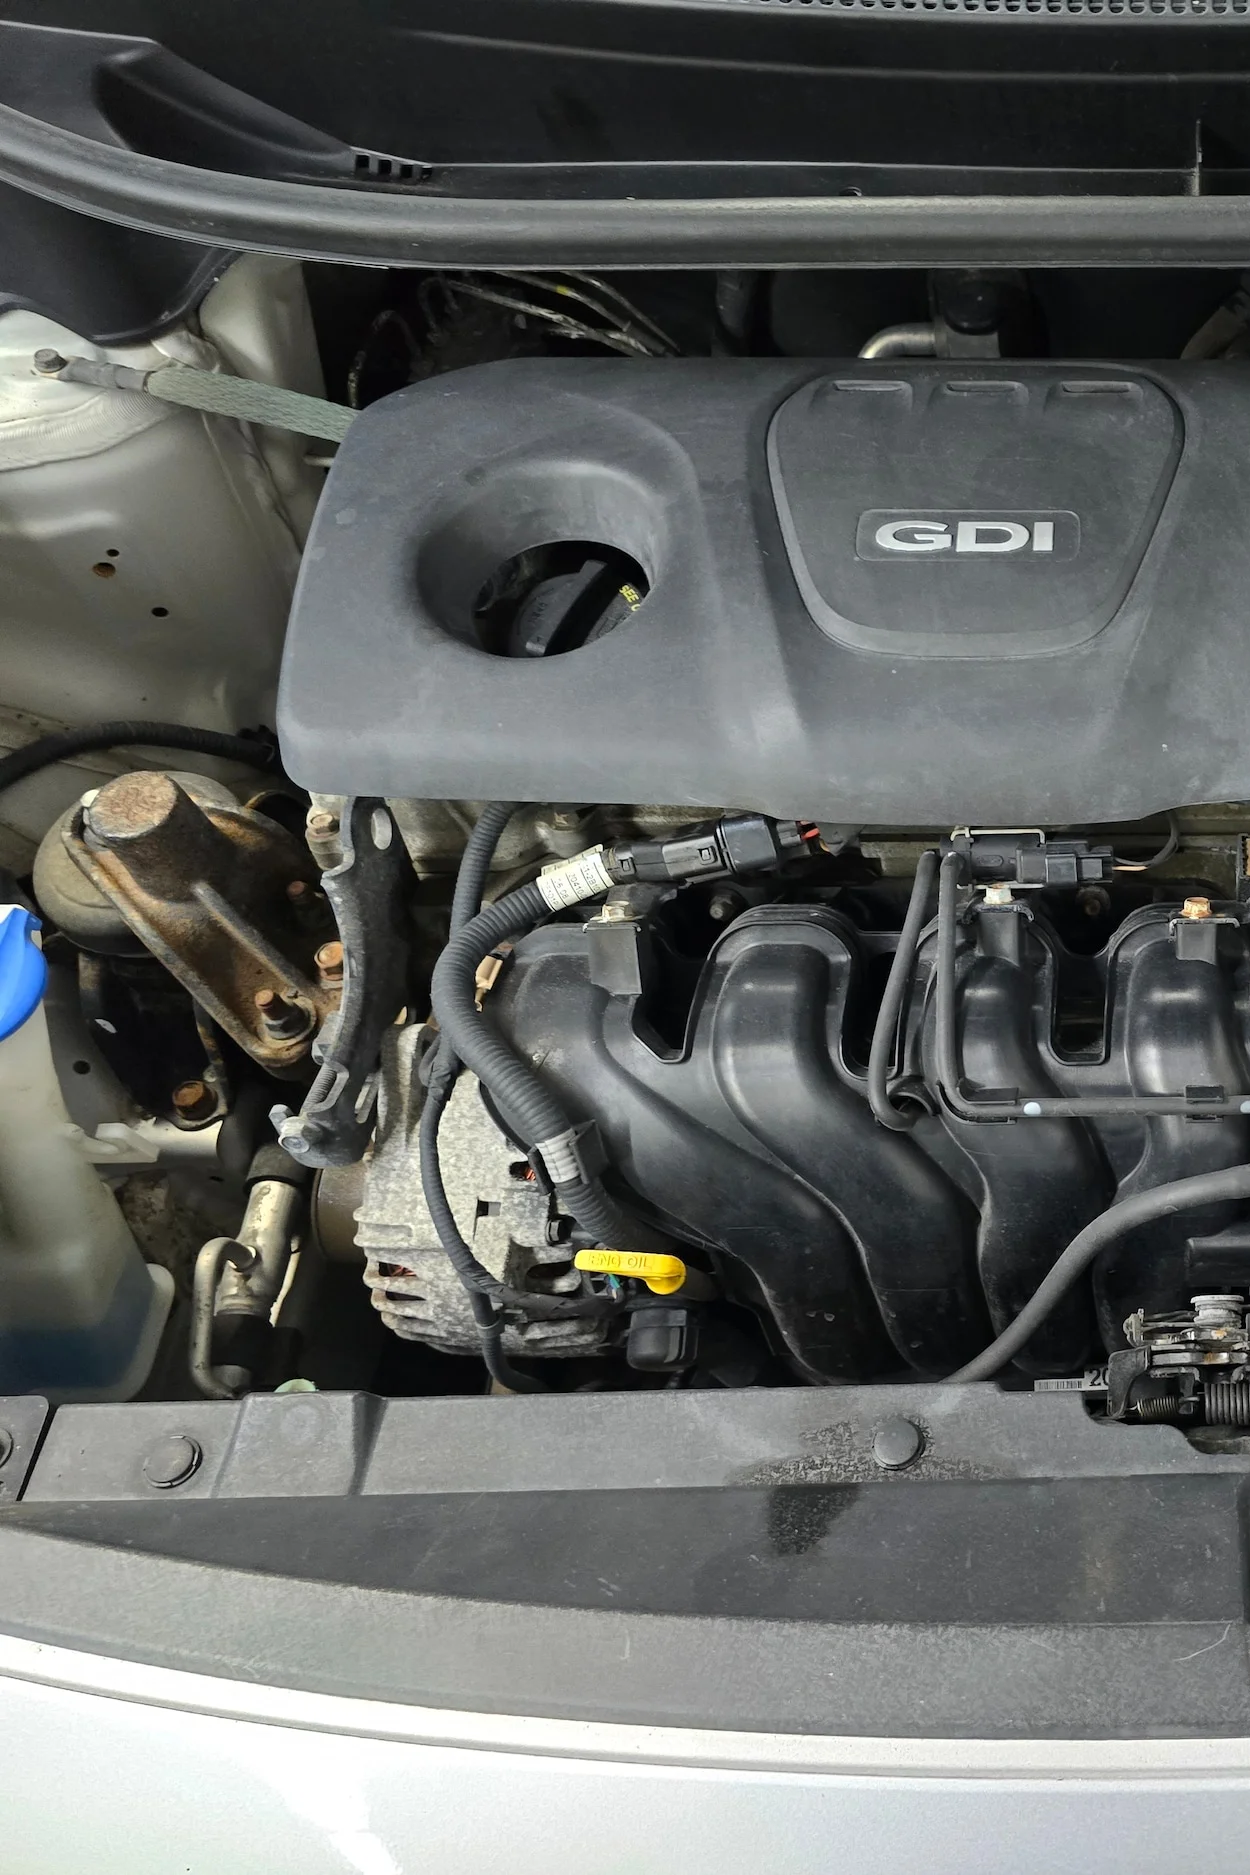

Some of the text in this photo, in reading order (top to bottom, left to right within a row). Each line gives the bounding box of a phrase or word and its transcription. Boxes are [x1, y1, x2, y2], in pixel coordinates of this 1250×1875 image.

[875, 519, 1054, 553] GDI
[618, 584, 640, 603] SEE
[627, 1255, 653, 1269] OIL
